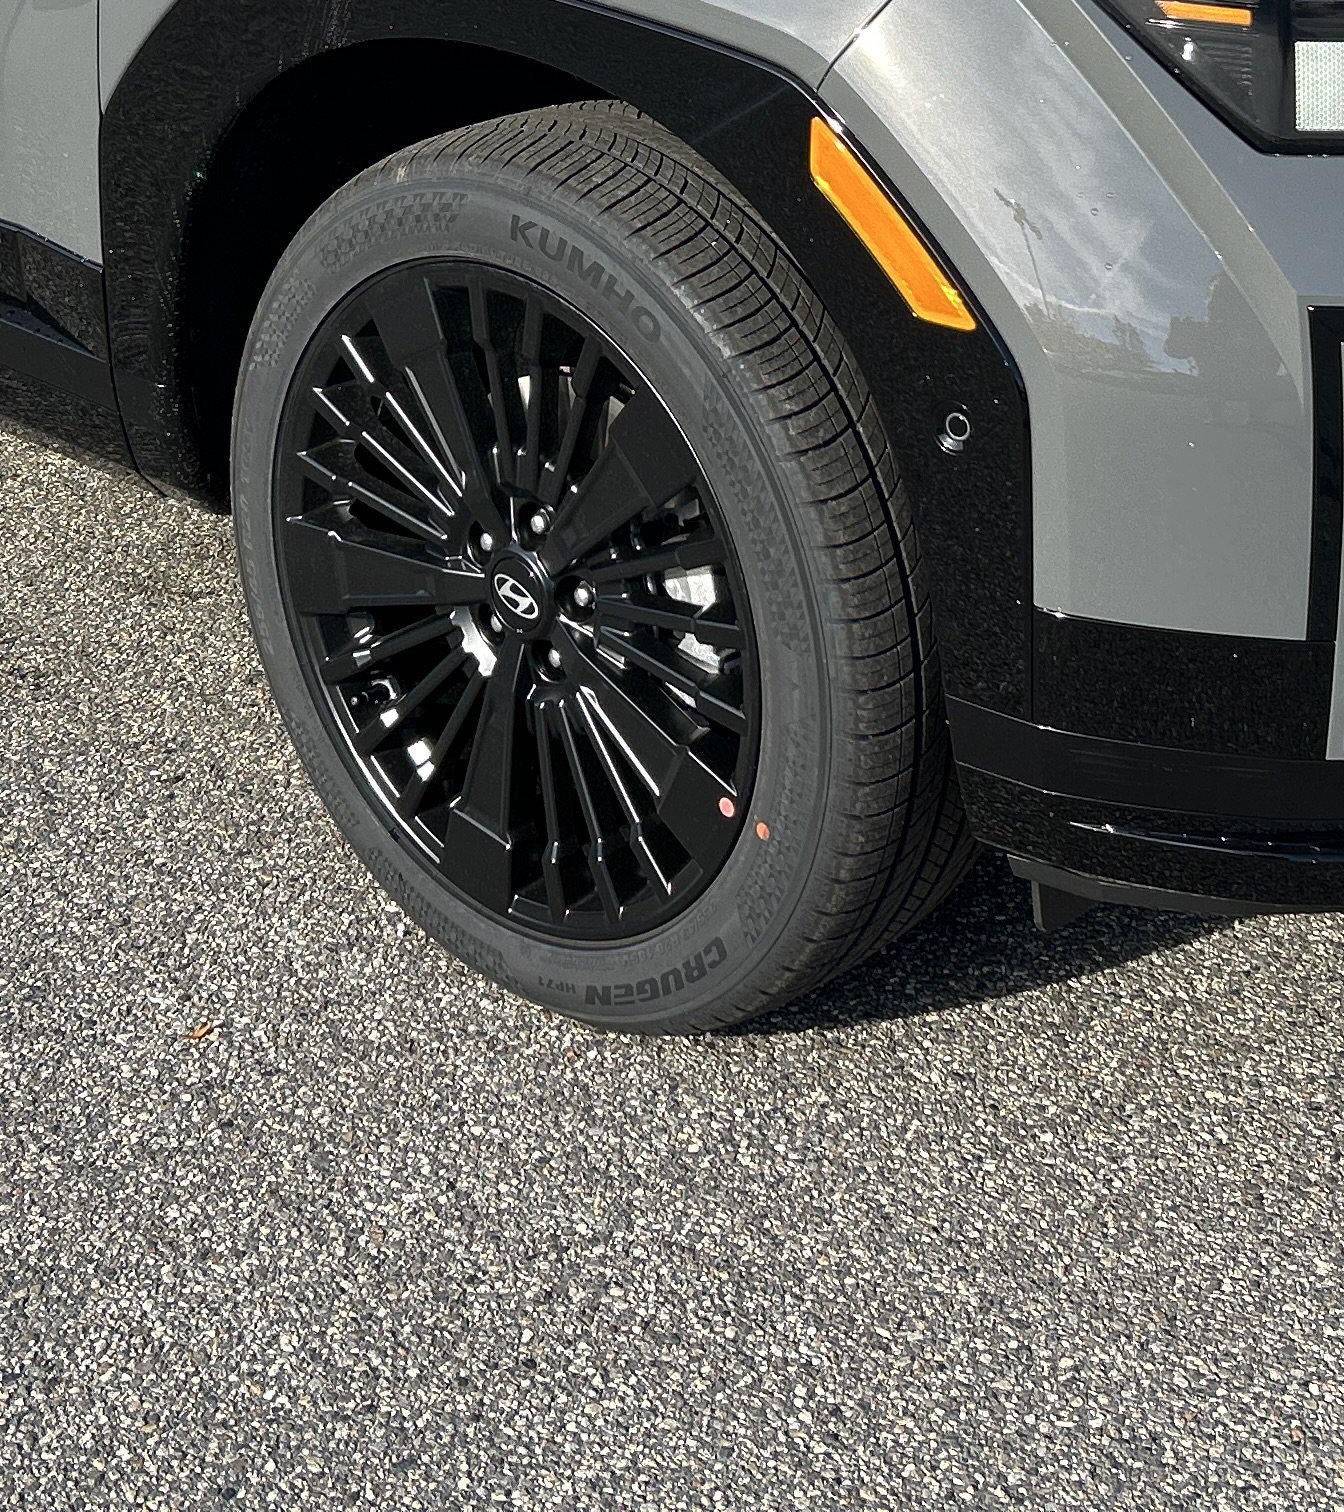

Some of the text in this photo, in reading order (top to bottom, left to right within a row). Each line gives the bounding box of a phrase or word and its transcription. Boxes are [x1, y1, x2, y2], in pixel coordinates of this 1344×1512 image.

[510, 214, 661, 343] KUMHO
[537, 975, 577, 995] HP71
[585, 936, 728, 1006] CRUGEN
